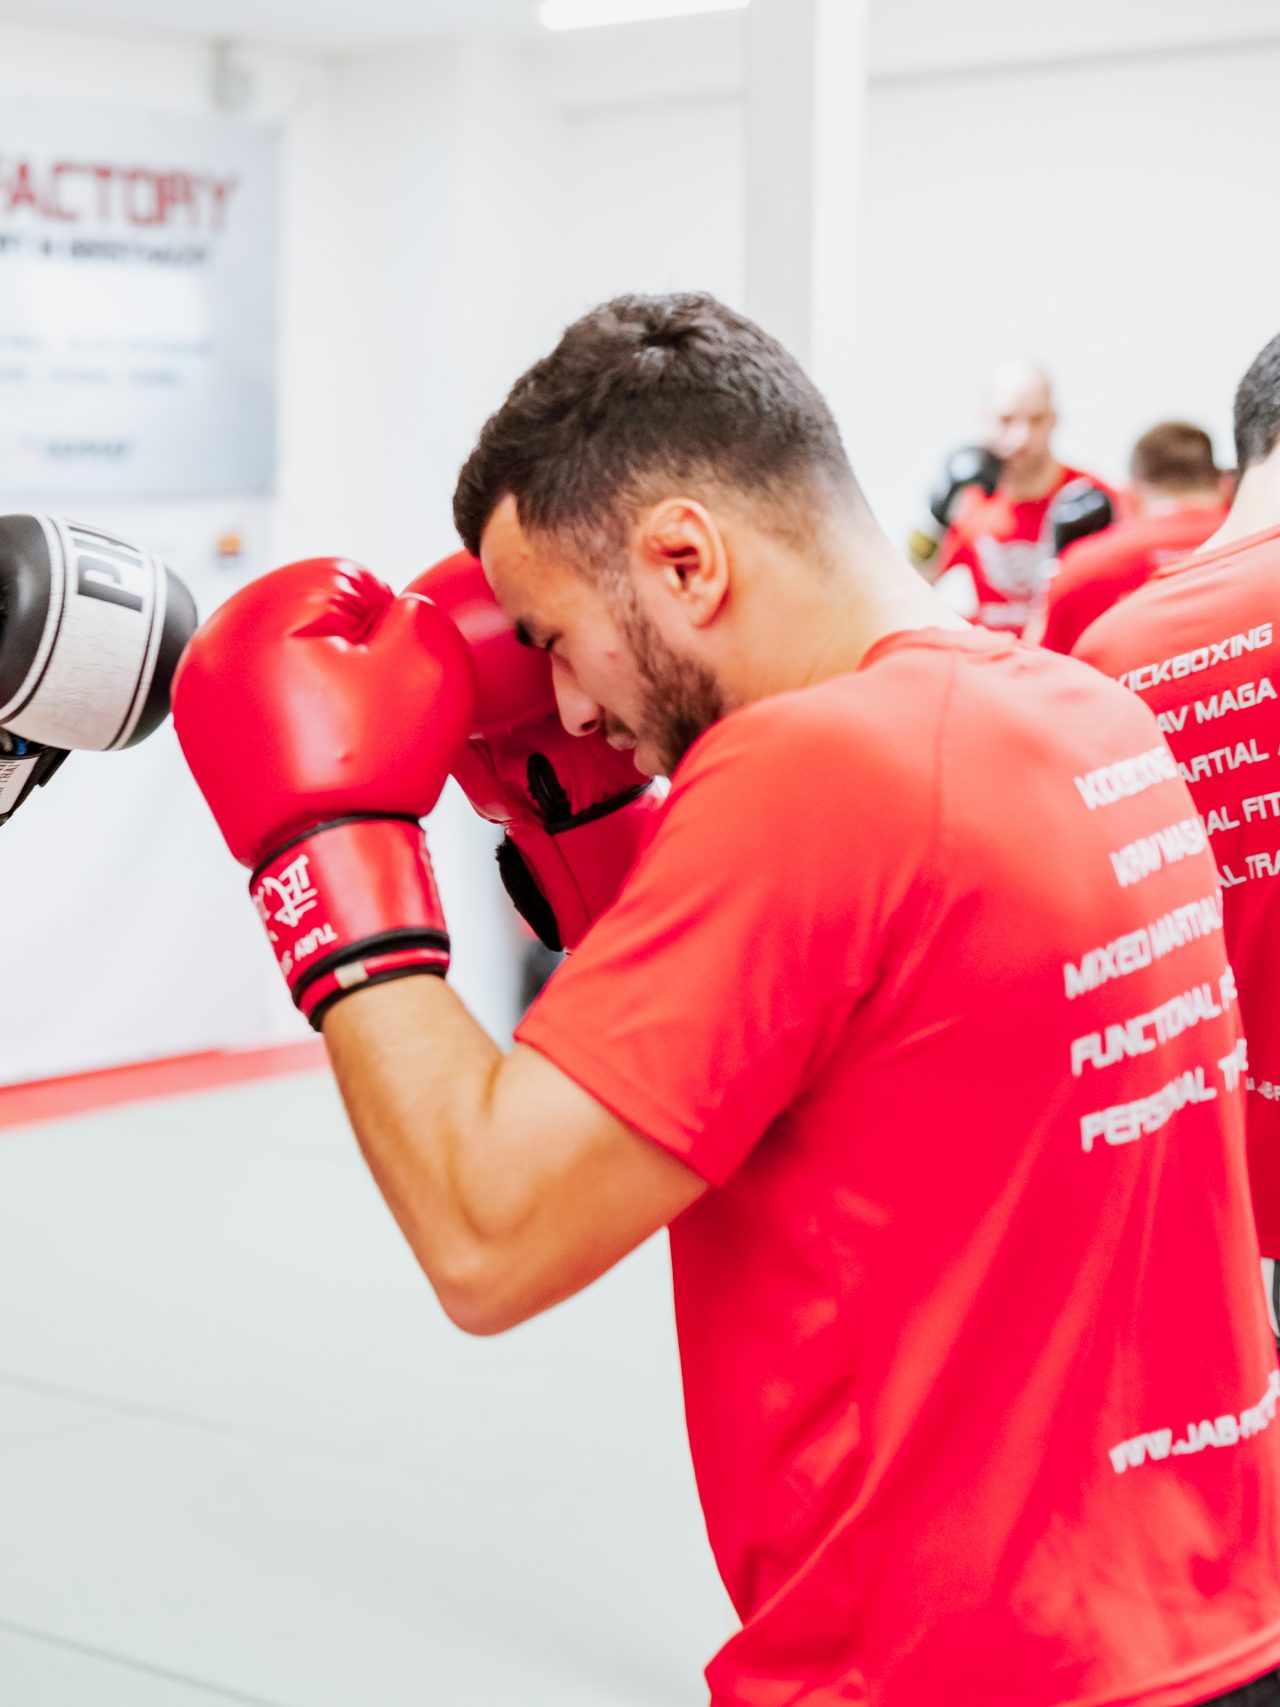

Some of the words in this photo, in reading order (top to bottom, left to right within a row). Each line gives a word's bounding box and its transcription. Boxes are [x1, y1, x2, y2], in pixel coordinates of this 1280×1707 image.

[1157, 705, 1188, 734] AV
[1194, 677, 1278, 724] MAGA
[1178, 738, 1269, 783] ARTIAL
[1063, 928, 1152, 1000] MIXED
